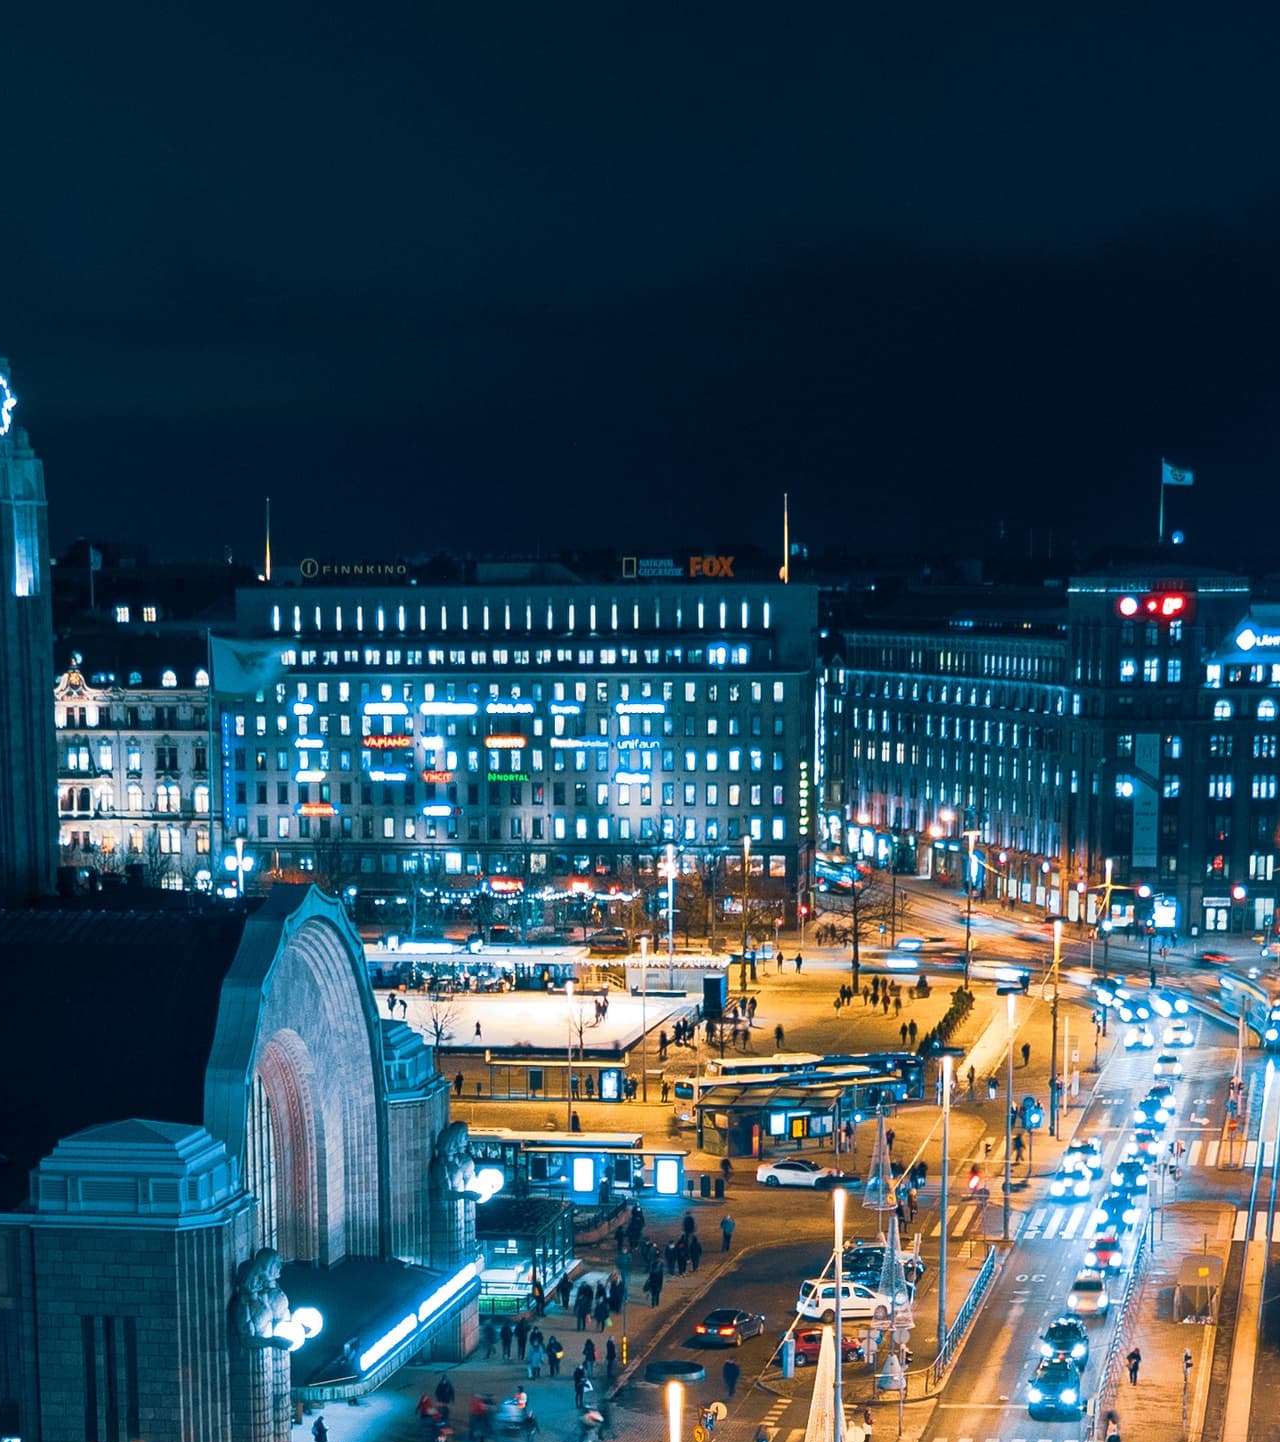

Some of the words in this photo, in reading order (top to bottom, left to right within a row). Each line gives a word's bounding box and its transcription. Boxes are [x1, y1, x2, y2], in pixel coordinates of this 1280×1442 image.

[638, 559, 674, 567] NATIONAL
[689, 556, 734, 577] FOX
[322, 564, 407, 575] FINNKINO
[363, 736, 412, 749] VAPIANO
[617, 738, 661, 750] unifaun
[423, 771, 452, 783] VINCIT
